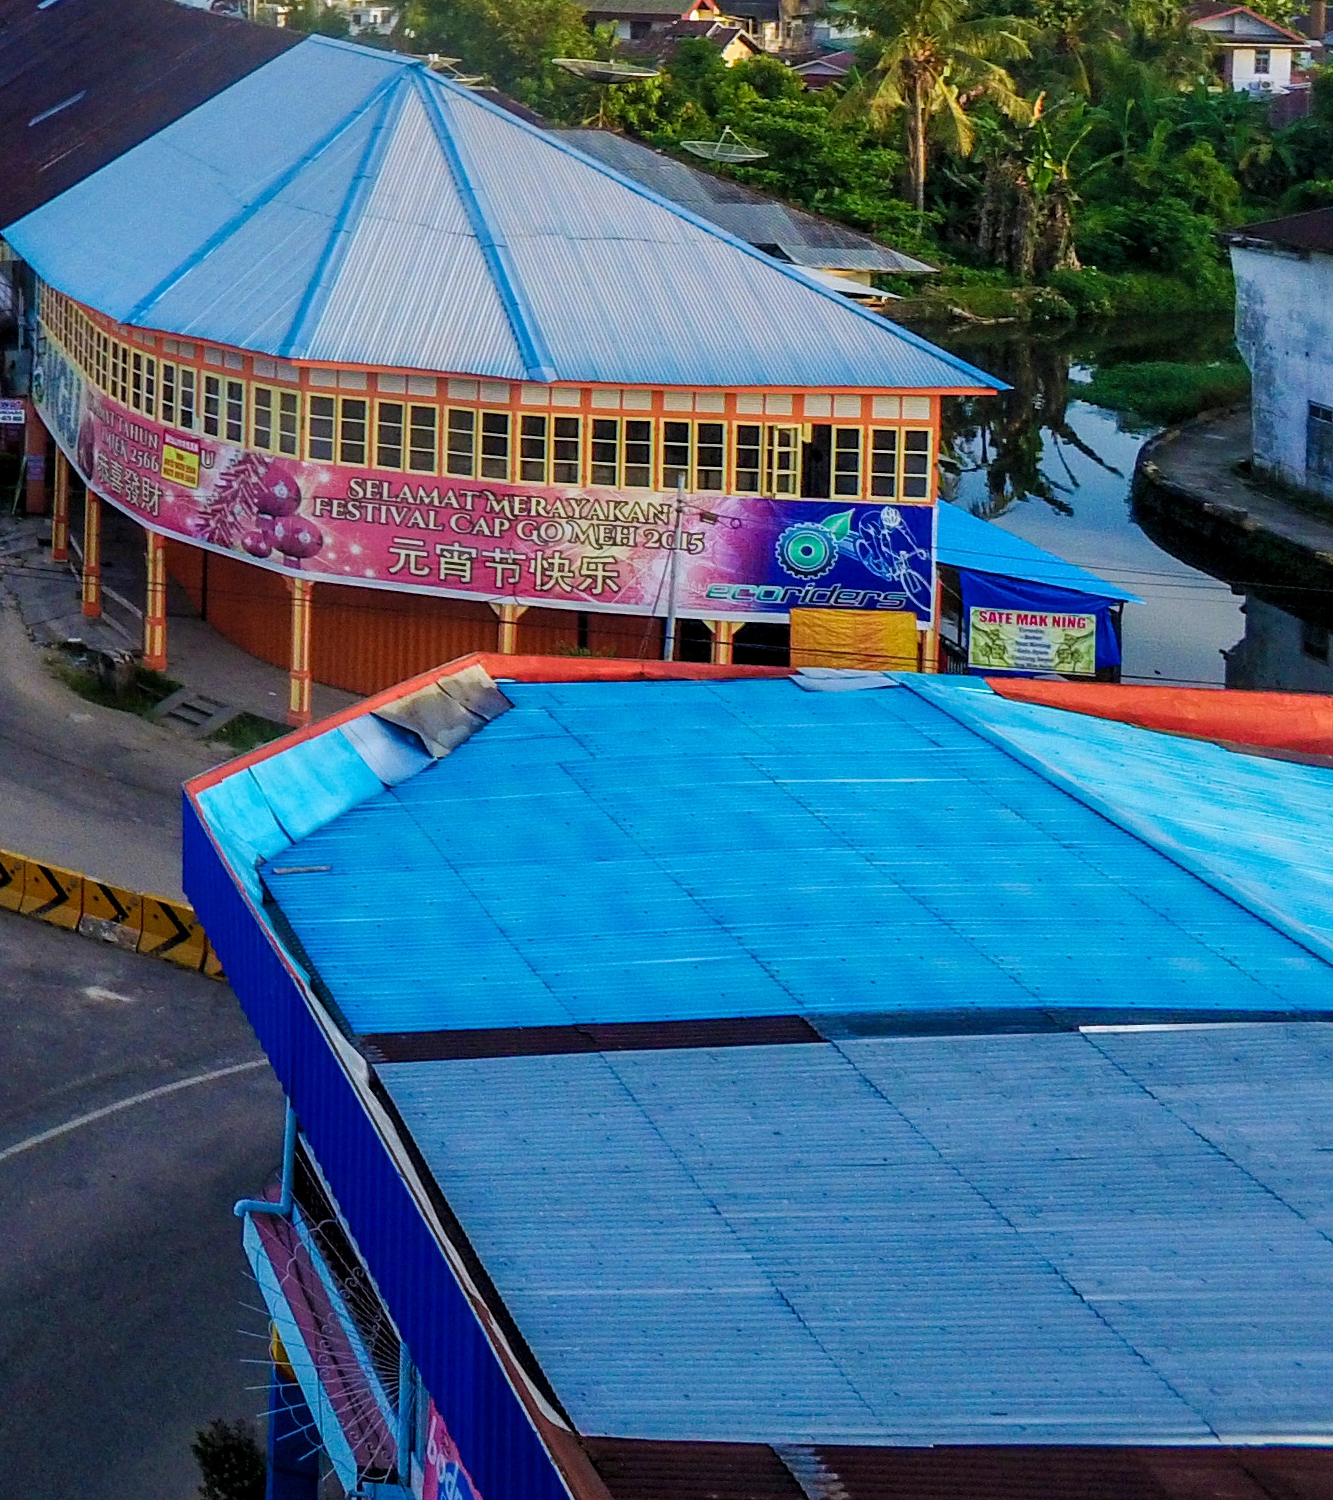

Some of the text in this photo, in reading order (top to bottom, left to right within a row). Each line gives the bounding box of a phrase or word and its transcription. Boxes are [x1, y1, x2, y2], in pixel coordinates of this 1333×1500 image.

[117, 414, 159, 450] TAHUN
[130, 450, 161, 473] 2566
[96, 450, 163, 517] 恭喜發財
[347, 477, 672, 525] SELAMAT MERAYAKAN
[312, 496, 444, 532] FESTIVAL
[449, 513, 511, 538] CAP
[516, 519, 565, 546] GO
[568, 519, 637, 550] MEH
[388, 536, 621, 596] 元宵节快乐
[705, 581, 909, 609] ecoriders
[979, 610, 1086, 629] SATE MAK NING
